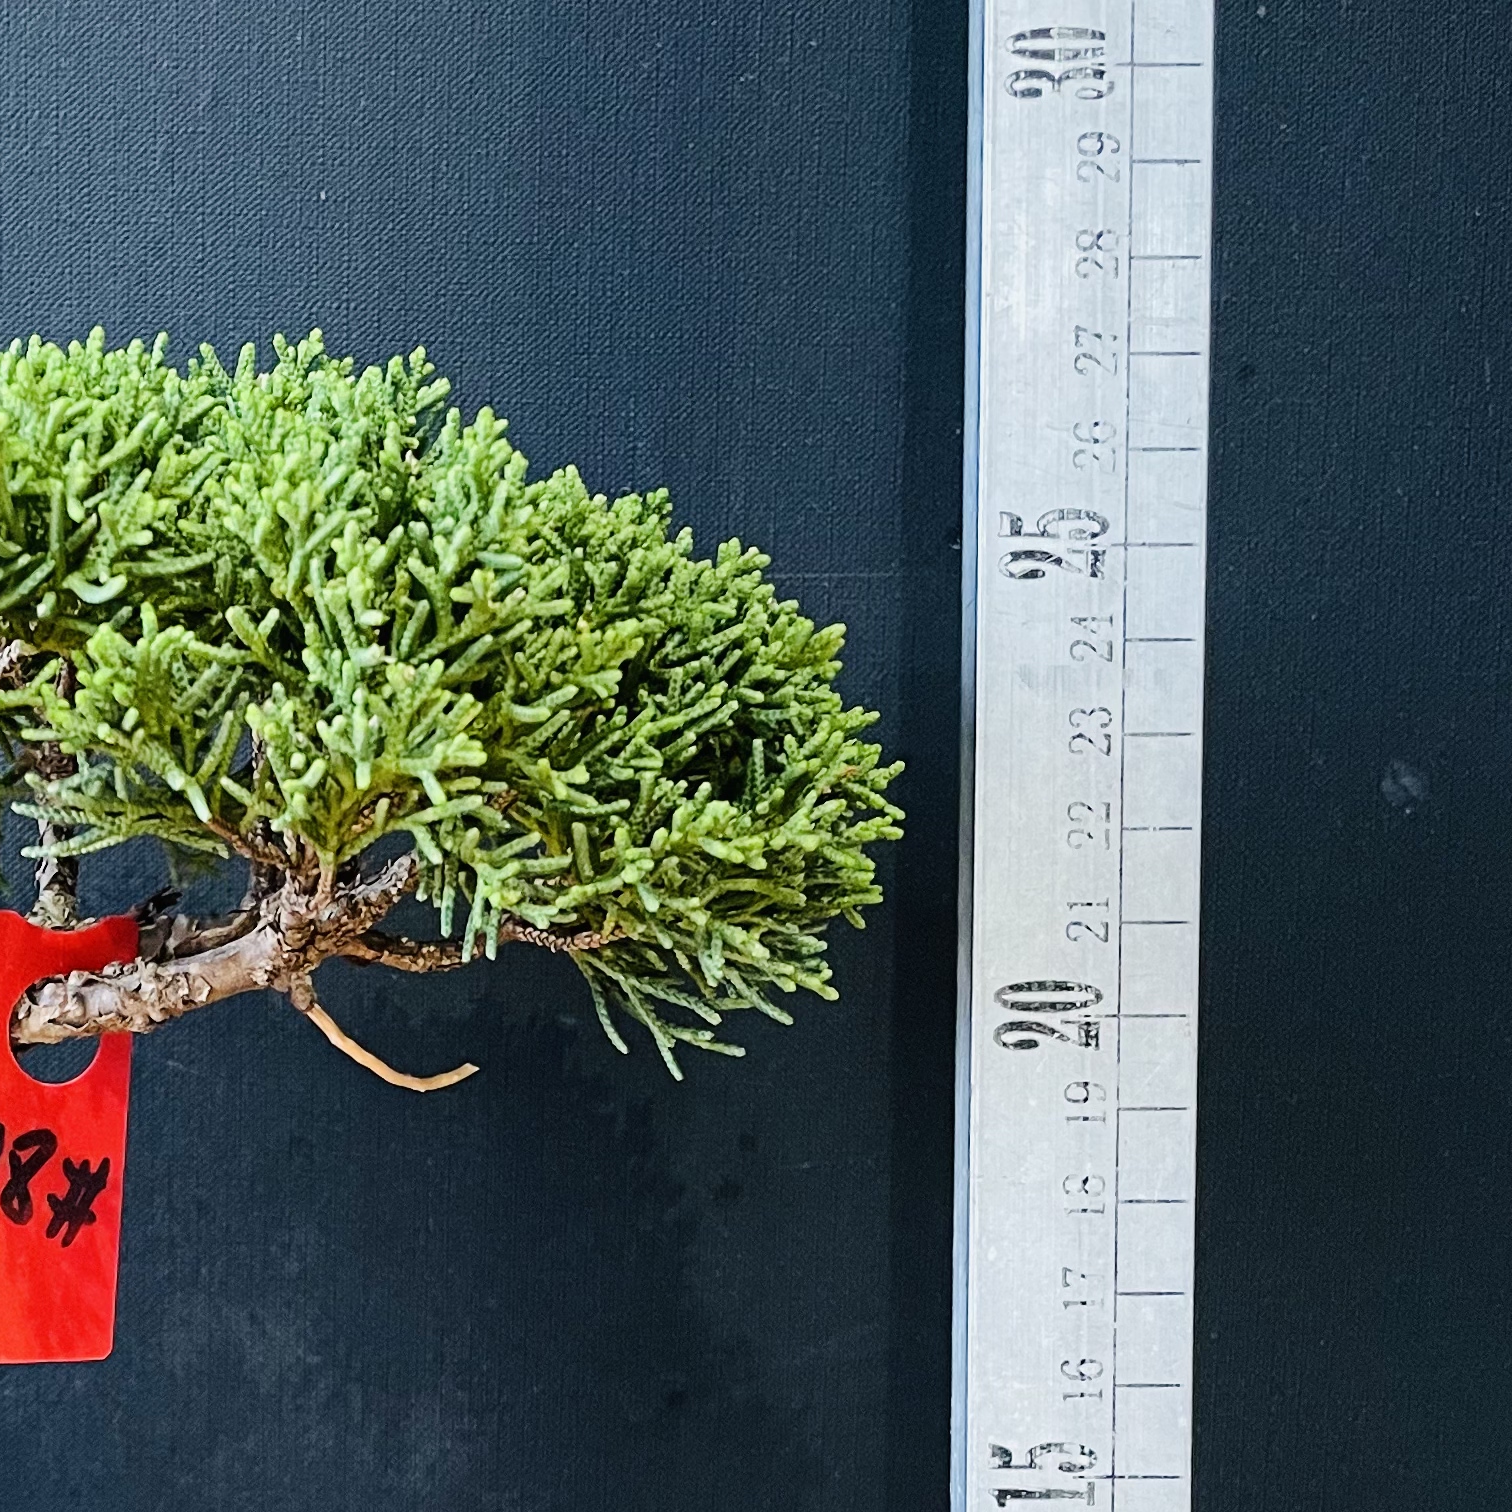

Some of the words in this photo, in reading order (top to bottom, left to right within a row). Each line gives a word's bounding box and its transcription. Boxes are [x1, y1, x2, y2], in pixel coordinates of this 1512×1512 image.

[1005, 26, 1115, 100] 30
[1076, 131, 1120, 184] 29
[1075, 228, 1120, 280] 28
[1073, 325, 1118, 376] 27
[1072, 420, 1117, 473] 26
[998, 508, 1110, 580] 25
[1070, 614, 1114, 663] 24
[1068, 706, 1113, 757] 23
[1066, 801, 1111, 850] 22
[1065, 897, 1110, 943] 21
[993, 979, 1104, 1052] 20
[1063, 1081, 1107, 1125] 19
[1062, 1173, 1106, 1215] 18
[1062, 1266, 1105, 1310] 17
[1060, 1358, 1104, 1401] 16
[988, 1441, 1098, 1508] 15
